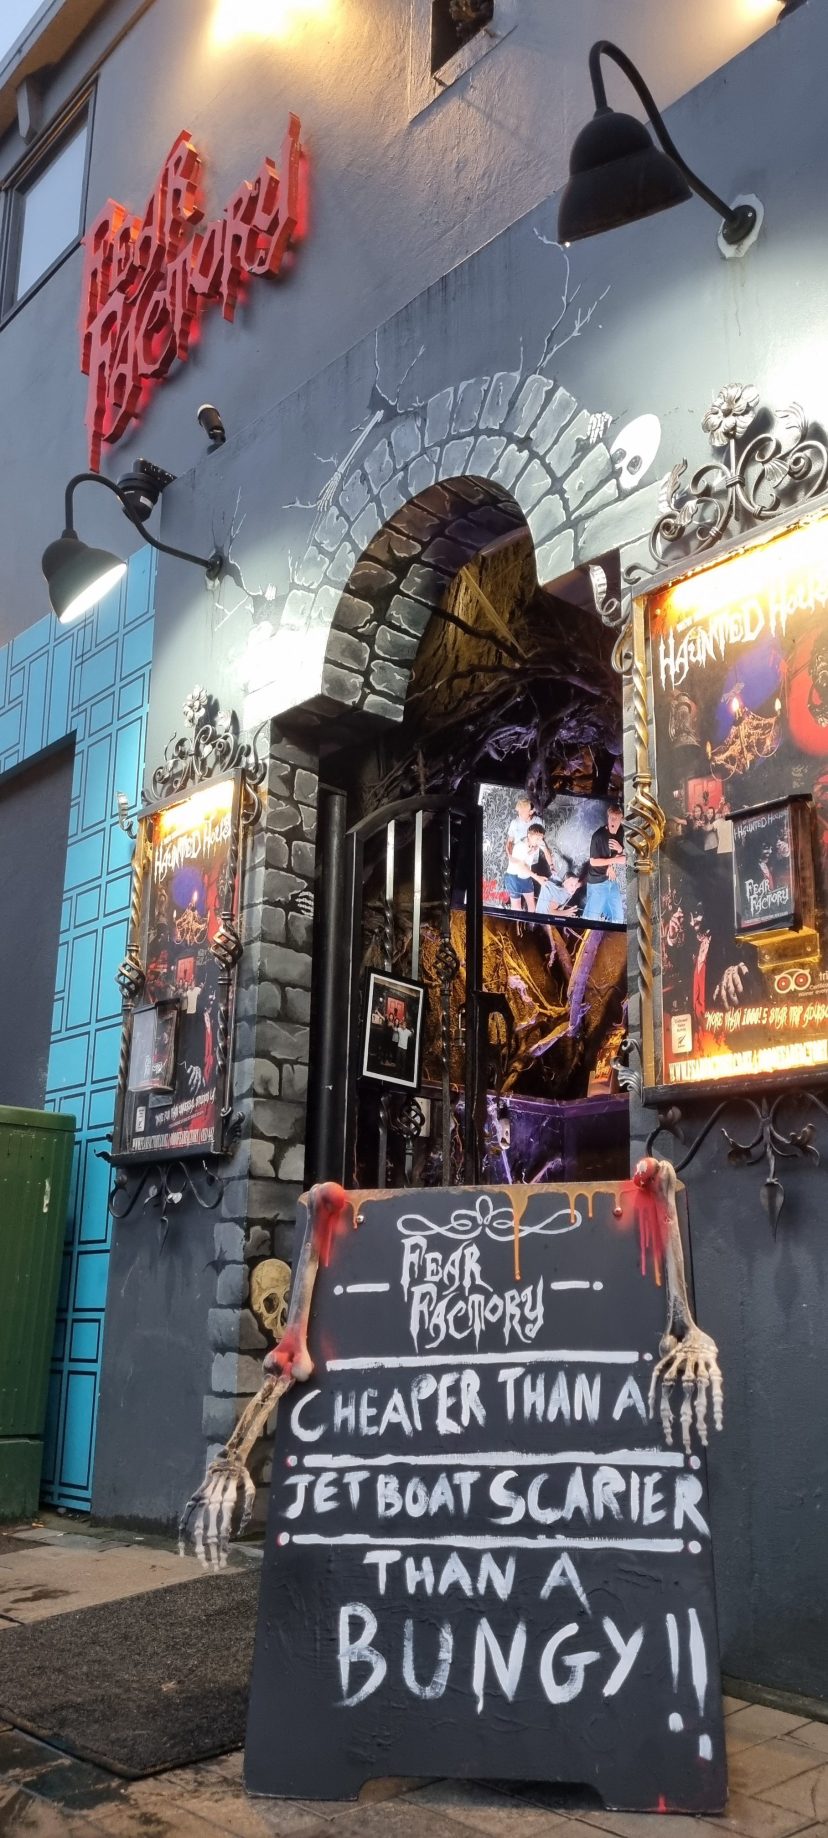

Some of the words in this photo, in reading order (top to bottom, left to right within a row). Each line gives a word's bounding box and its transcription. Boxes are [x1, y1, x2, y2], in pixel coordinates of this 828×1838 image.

[750, 886, 789, 917] FACTORY
[400, 1235, 484, 1302] FEAR
[408, 1275, 545, 1353] FACTORY
[290, 1369, 487, 1443] CHEAPER
[497, 1367, 603, 1423] THAN
[612, 1375, 650, 1425] A
[488, 1466, 711, 1537] SCARIER
[362, 1550, 517, 1603] THAN
[540, 1552, 592, 1613] A
